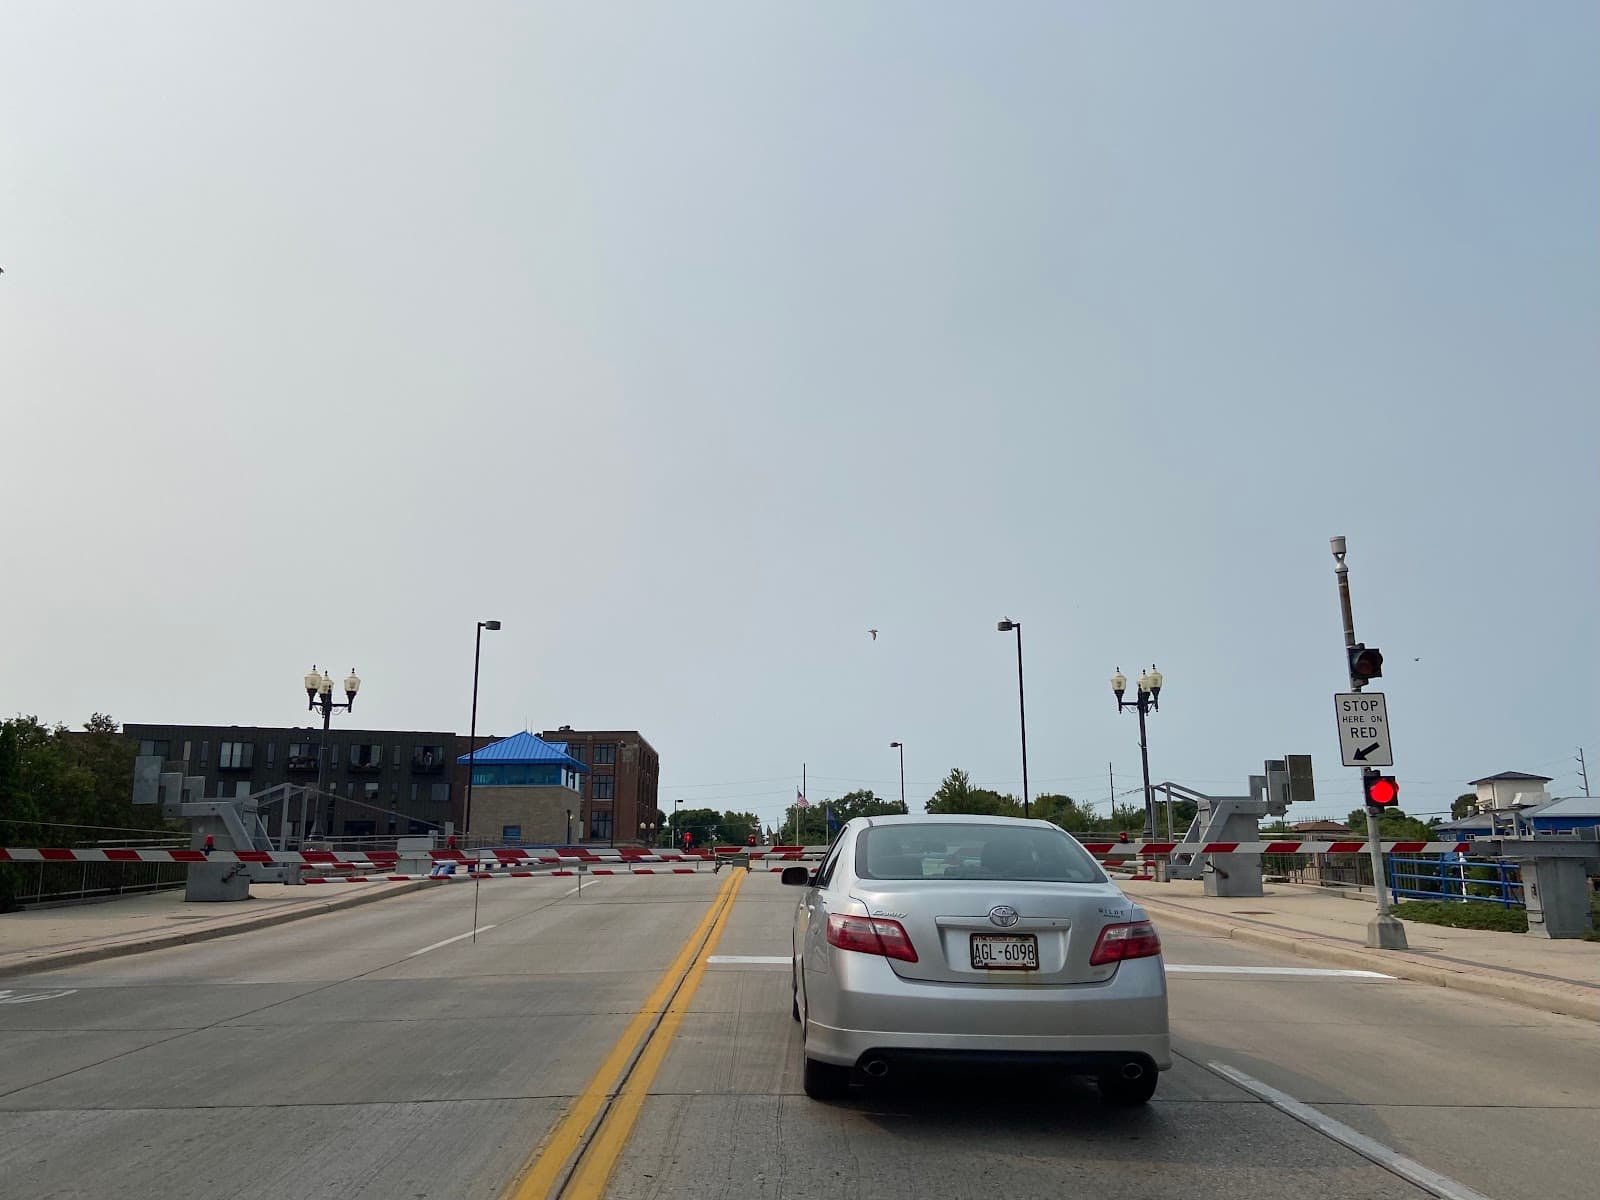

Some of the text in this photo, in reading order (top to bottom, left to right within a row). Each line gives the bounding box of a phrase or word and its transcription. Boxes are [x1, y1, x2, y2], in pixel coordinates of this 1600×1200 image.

[1343, 700, 1378, 712] STOP
[1342, 715, 1383, 723] HERE ON
[1350, 726, 1377, 739] RED
[974, 943, 1035, 961] AGL-6098
